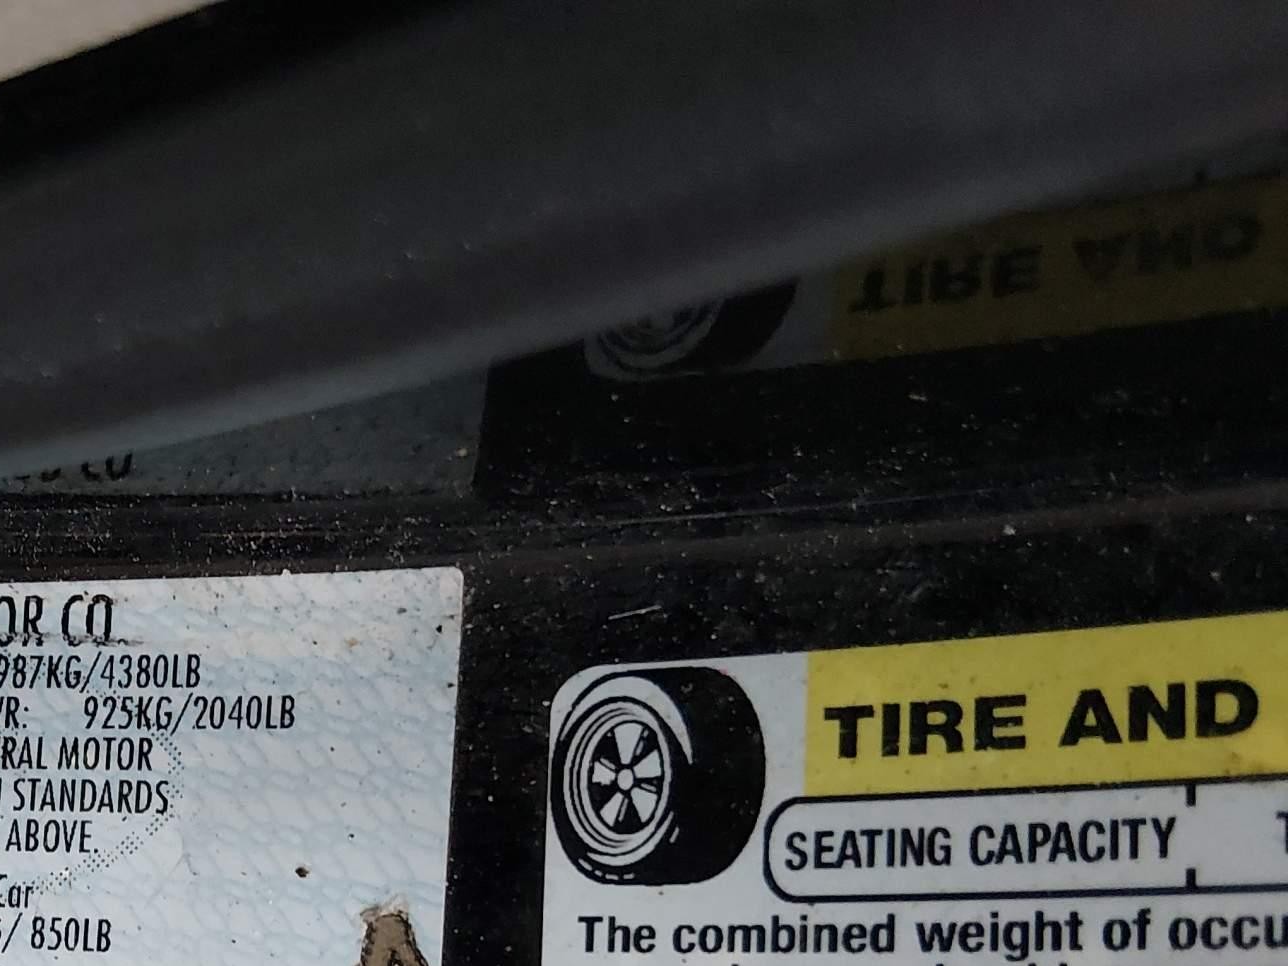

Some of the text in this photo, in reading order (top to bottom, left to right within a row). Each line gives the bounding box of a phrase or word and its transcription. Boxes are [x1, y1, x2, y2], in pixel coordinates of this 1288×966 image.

[61, 594, 128, 647] CO.
[83, 695, 295, 735] 925KG/2040LB
[824, 679, 1259, 761] TIRE AND
[57, 737, 153, 771] MOTOR
[13, 779, 169, 815] STANDARDS
[6, 819, 100, 855] ABOVE.
[784, 816, 1178, 871] SEATING CAPACITY
[30, 916, 112, 953] 850LB
[578, 915, 657, 954] The
[672, 913, 896, 955] combined
[917, 909, 1083, 960] weight
[1102, 909, 1152, 951] of
